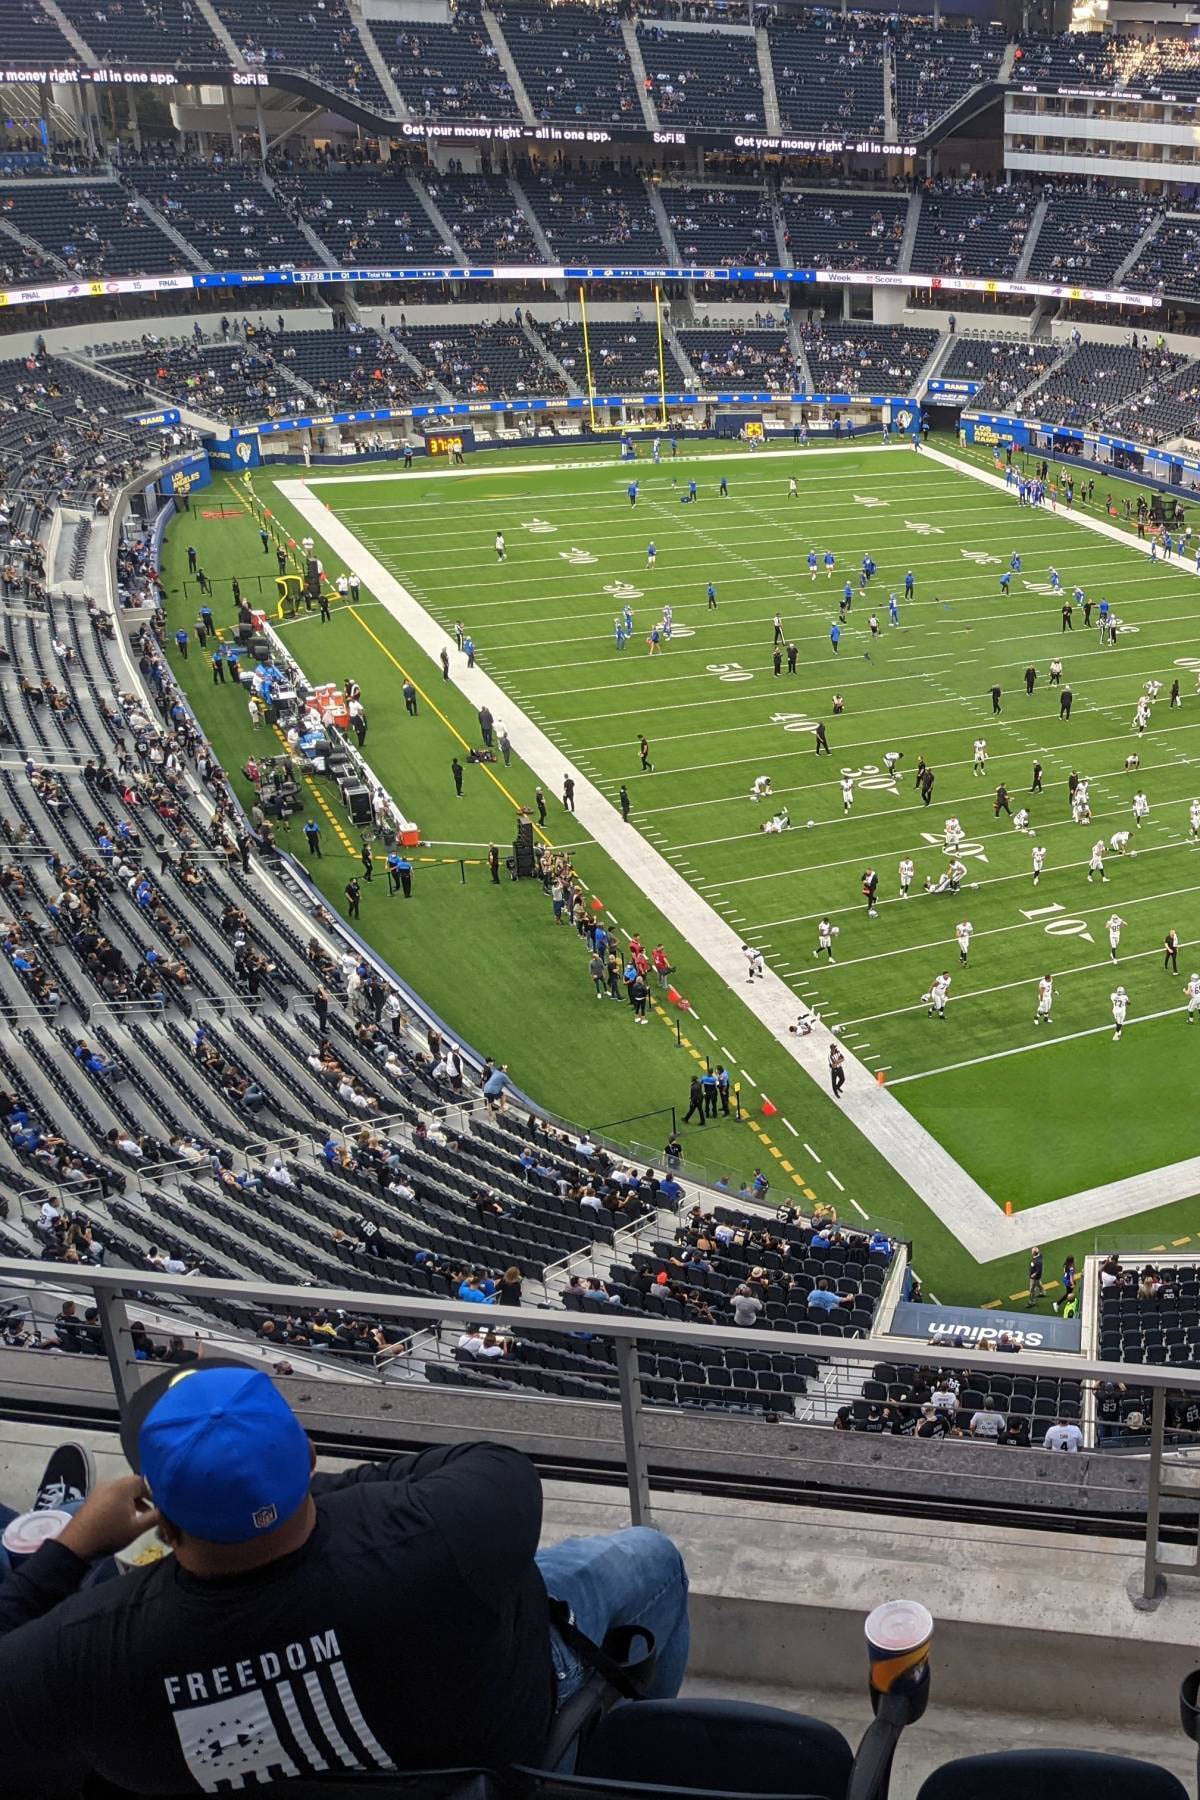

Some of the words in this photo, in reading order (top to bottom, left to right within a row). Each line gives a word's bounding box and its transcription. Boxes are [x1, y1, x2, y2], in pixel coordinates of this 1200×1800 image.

[6, 72, 46, 83] money
[94, 70, 107, 81] all
[109, 70, 121, 81] in
[124, 73, 147, 82] one
[151, 74, 177, 84] app.
[233, 73, 256, 84] SoFi
[403, 124, 424, 135] Get
[426, 127, 452, 137] your
[455, 128, 491, 138] money
[536, 128, 549, 138] all
[551, 128, 561, 138] in
[564, 131, 584, 139] one
[587, 132, 611, 142] app.
[654, 132, 674, 143] SoFi
[735, 136, 754, 146] Get
[756, 139, 779, 148] your
[781, 141, 816, 151] money
[857, 142, 868, 152] all
[871, 143, 880, 152] in
[883, 146, 902, 154] one
[904, 147, 916, 156] ap
[828, 273, 851, 282] Week
[875, 276, 902, 284] Scores
[22, 292, 40, 300] FINAL
[944, 383, 968, 391] RAMS
[140, 415, 165, 426] RAMS
[312, 417, 334, 425] RAMS
[238, 427, 259, 436] RAMS
[974, 425, 991, 433] LOS
[706, 662, 754, 682] 50
[840, 764, 896, 790] 30
[1019, 902, 1088, 934] 10
[928, 1322, 1044, 1346] Stadium
[1186, 1409, 1199, 1422] 83
[1061, 1441, 1068, 1451] 4
[164, 1628, 342, 1704] FREEDOM
